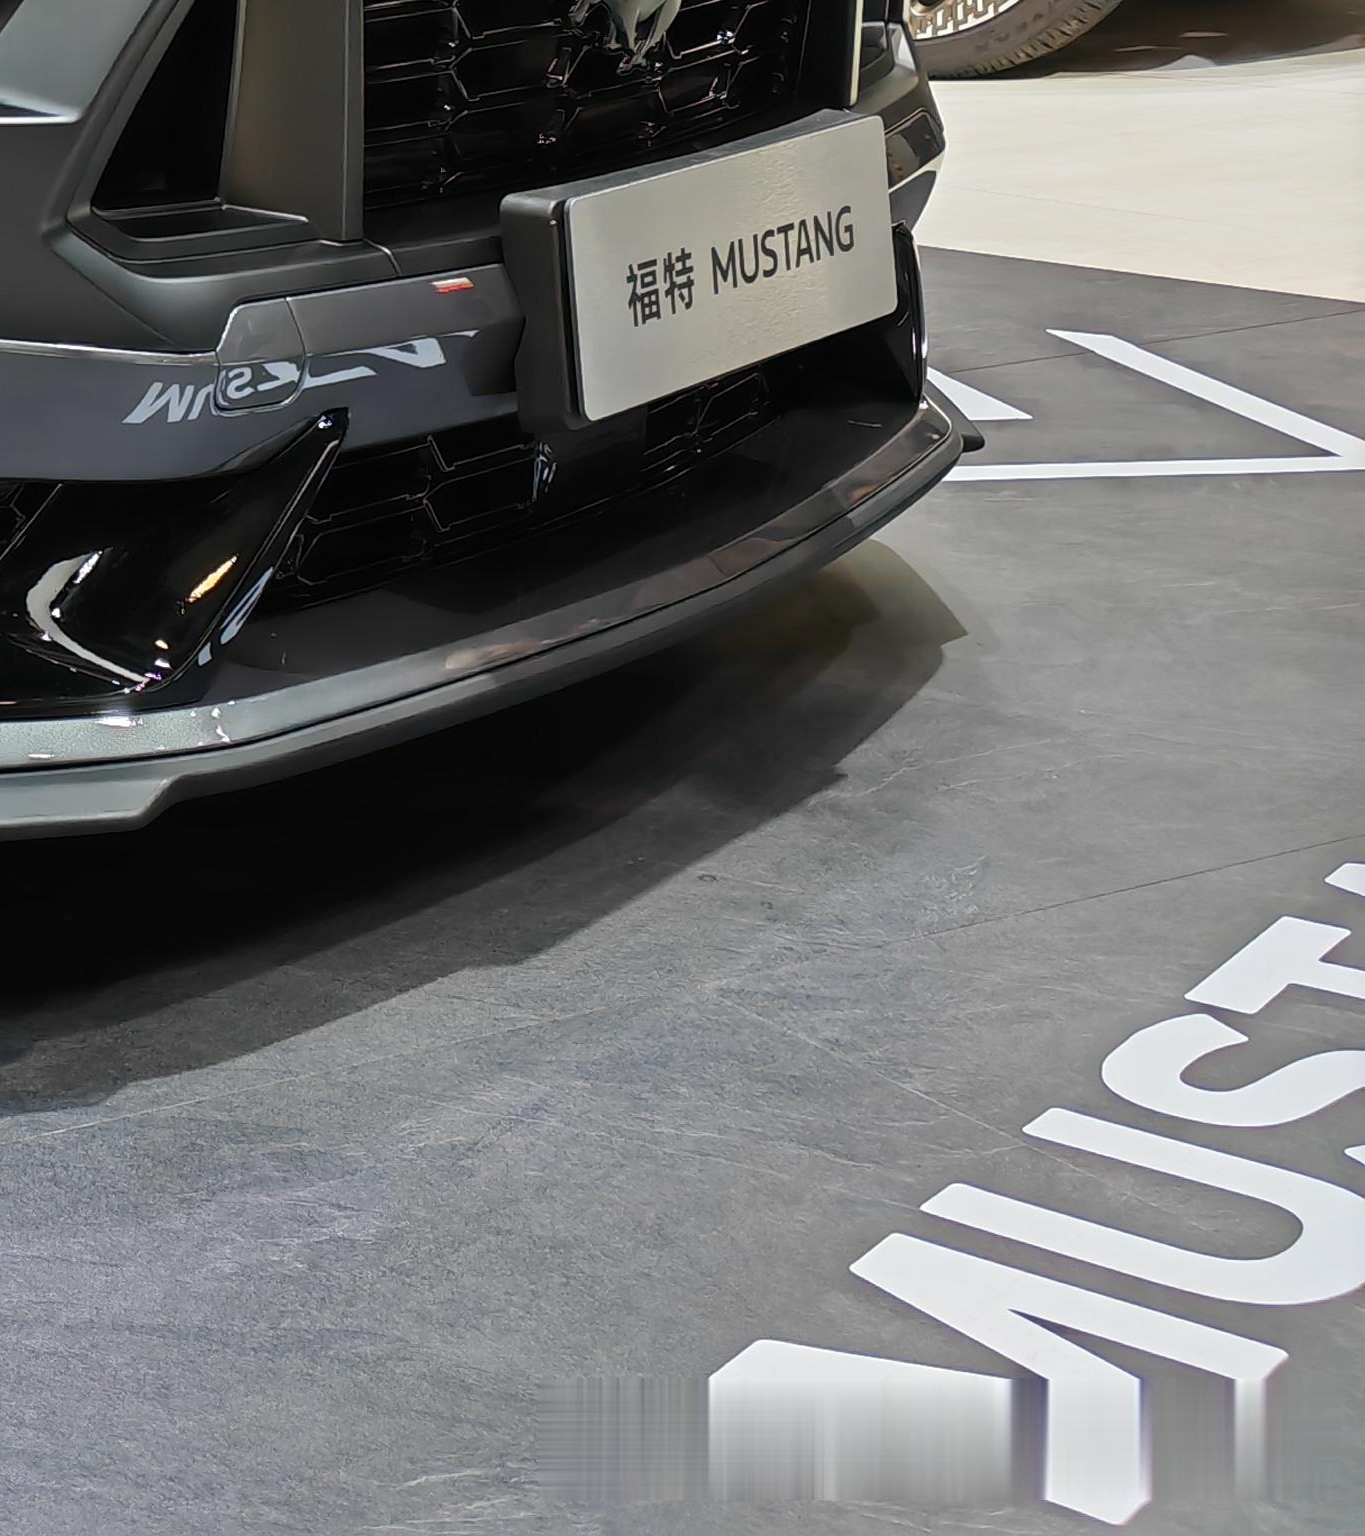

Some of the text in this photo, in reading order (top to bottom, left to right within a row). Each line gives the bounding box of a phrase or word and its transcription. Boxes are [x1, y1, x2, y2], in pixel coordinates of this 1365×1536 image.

[625, 205, 856, 328] 福特 MUSTANG
[708, 862, 1365, 1527] MUST
